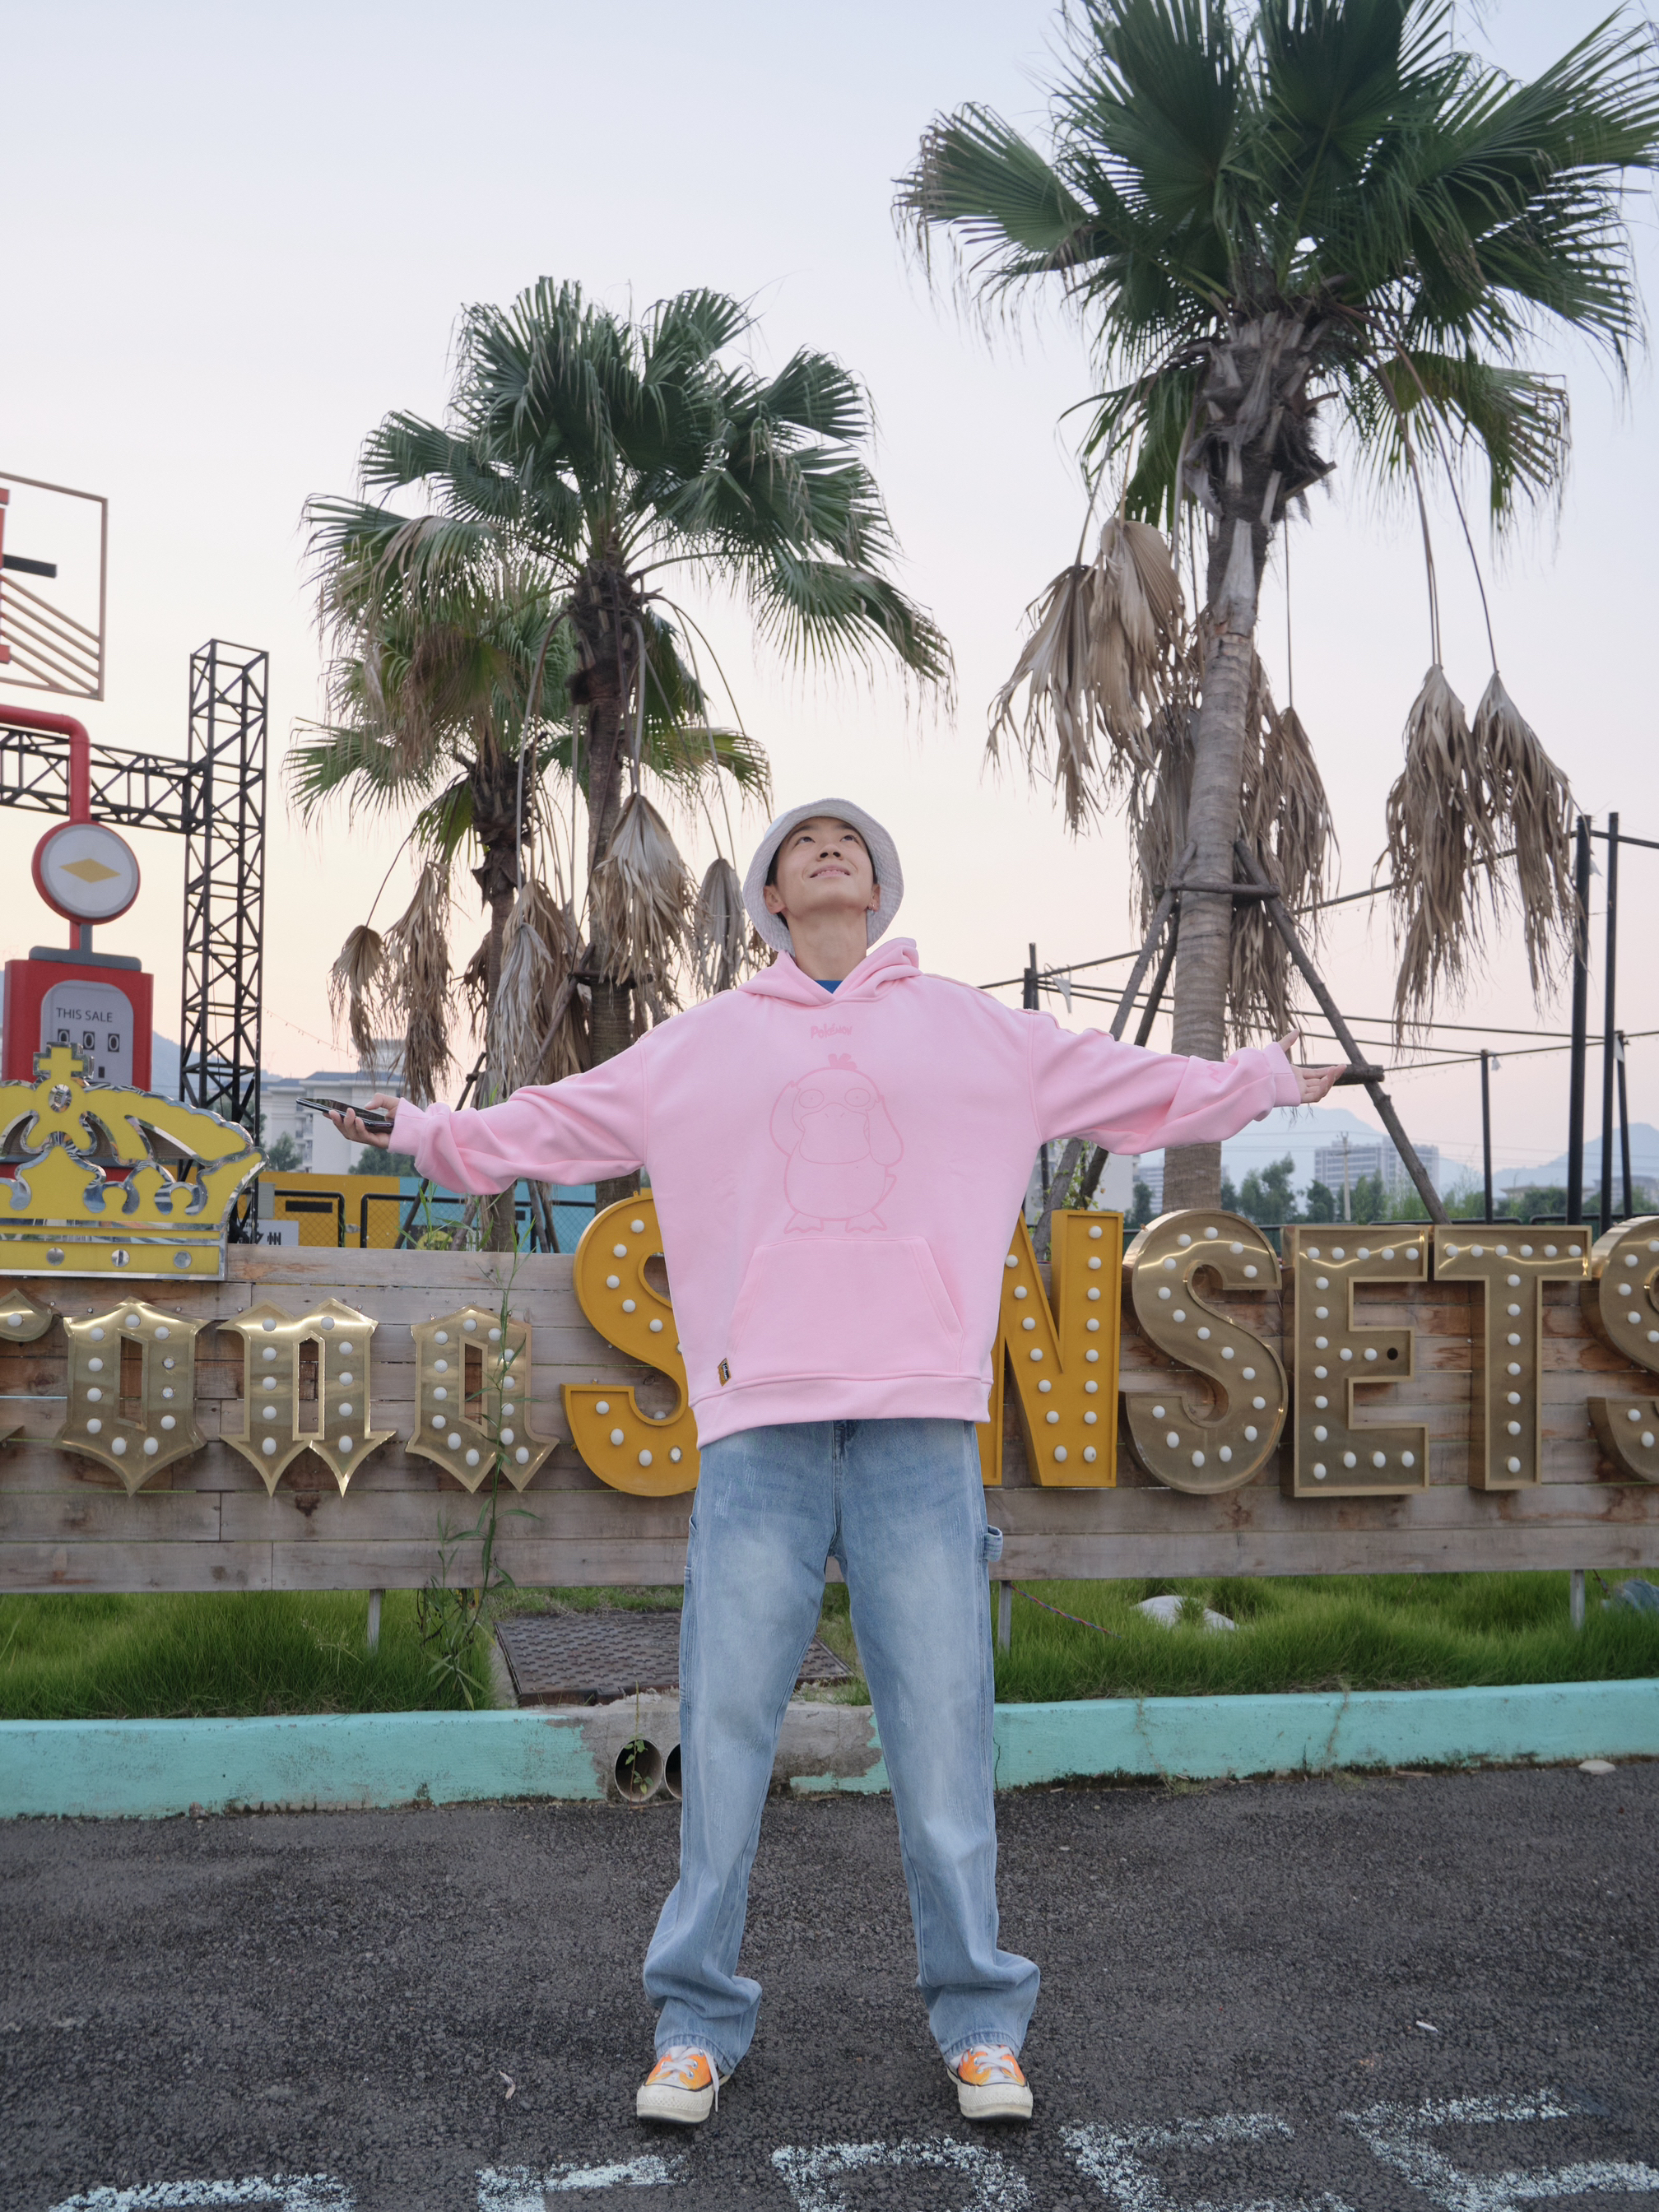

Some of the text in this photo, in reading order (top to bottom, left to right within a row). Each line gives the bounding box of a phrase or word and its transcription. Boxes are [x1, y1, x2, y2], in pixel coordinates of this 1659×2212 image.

[56, 1007, 113, 1022] THIS SALE
[560, 1190, 1659, 1498] SNSET
